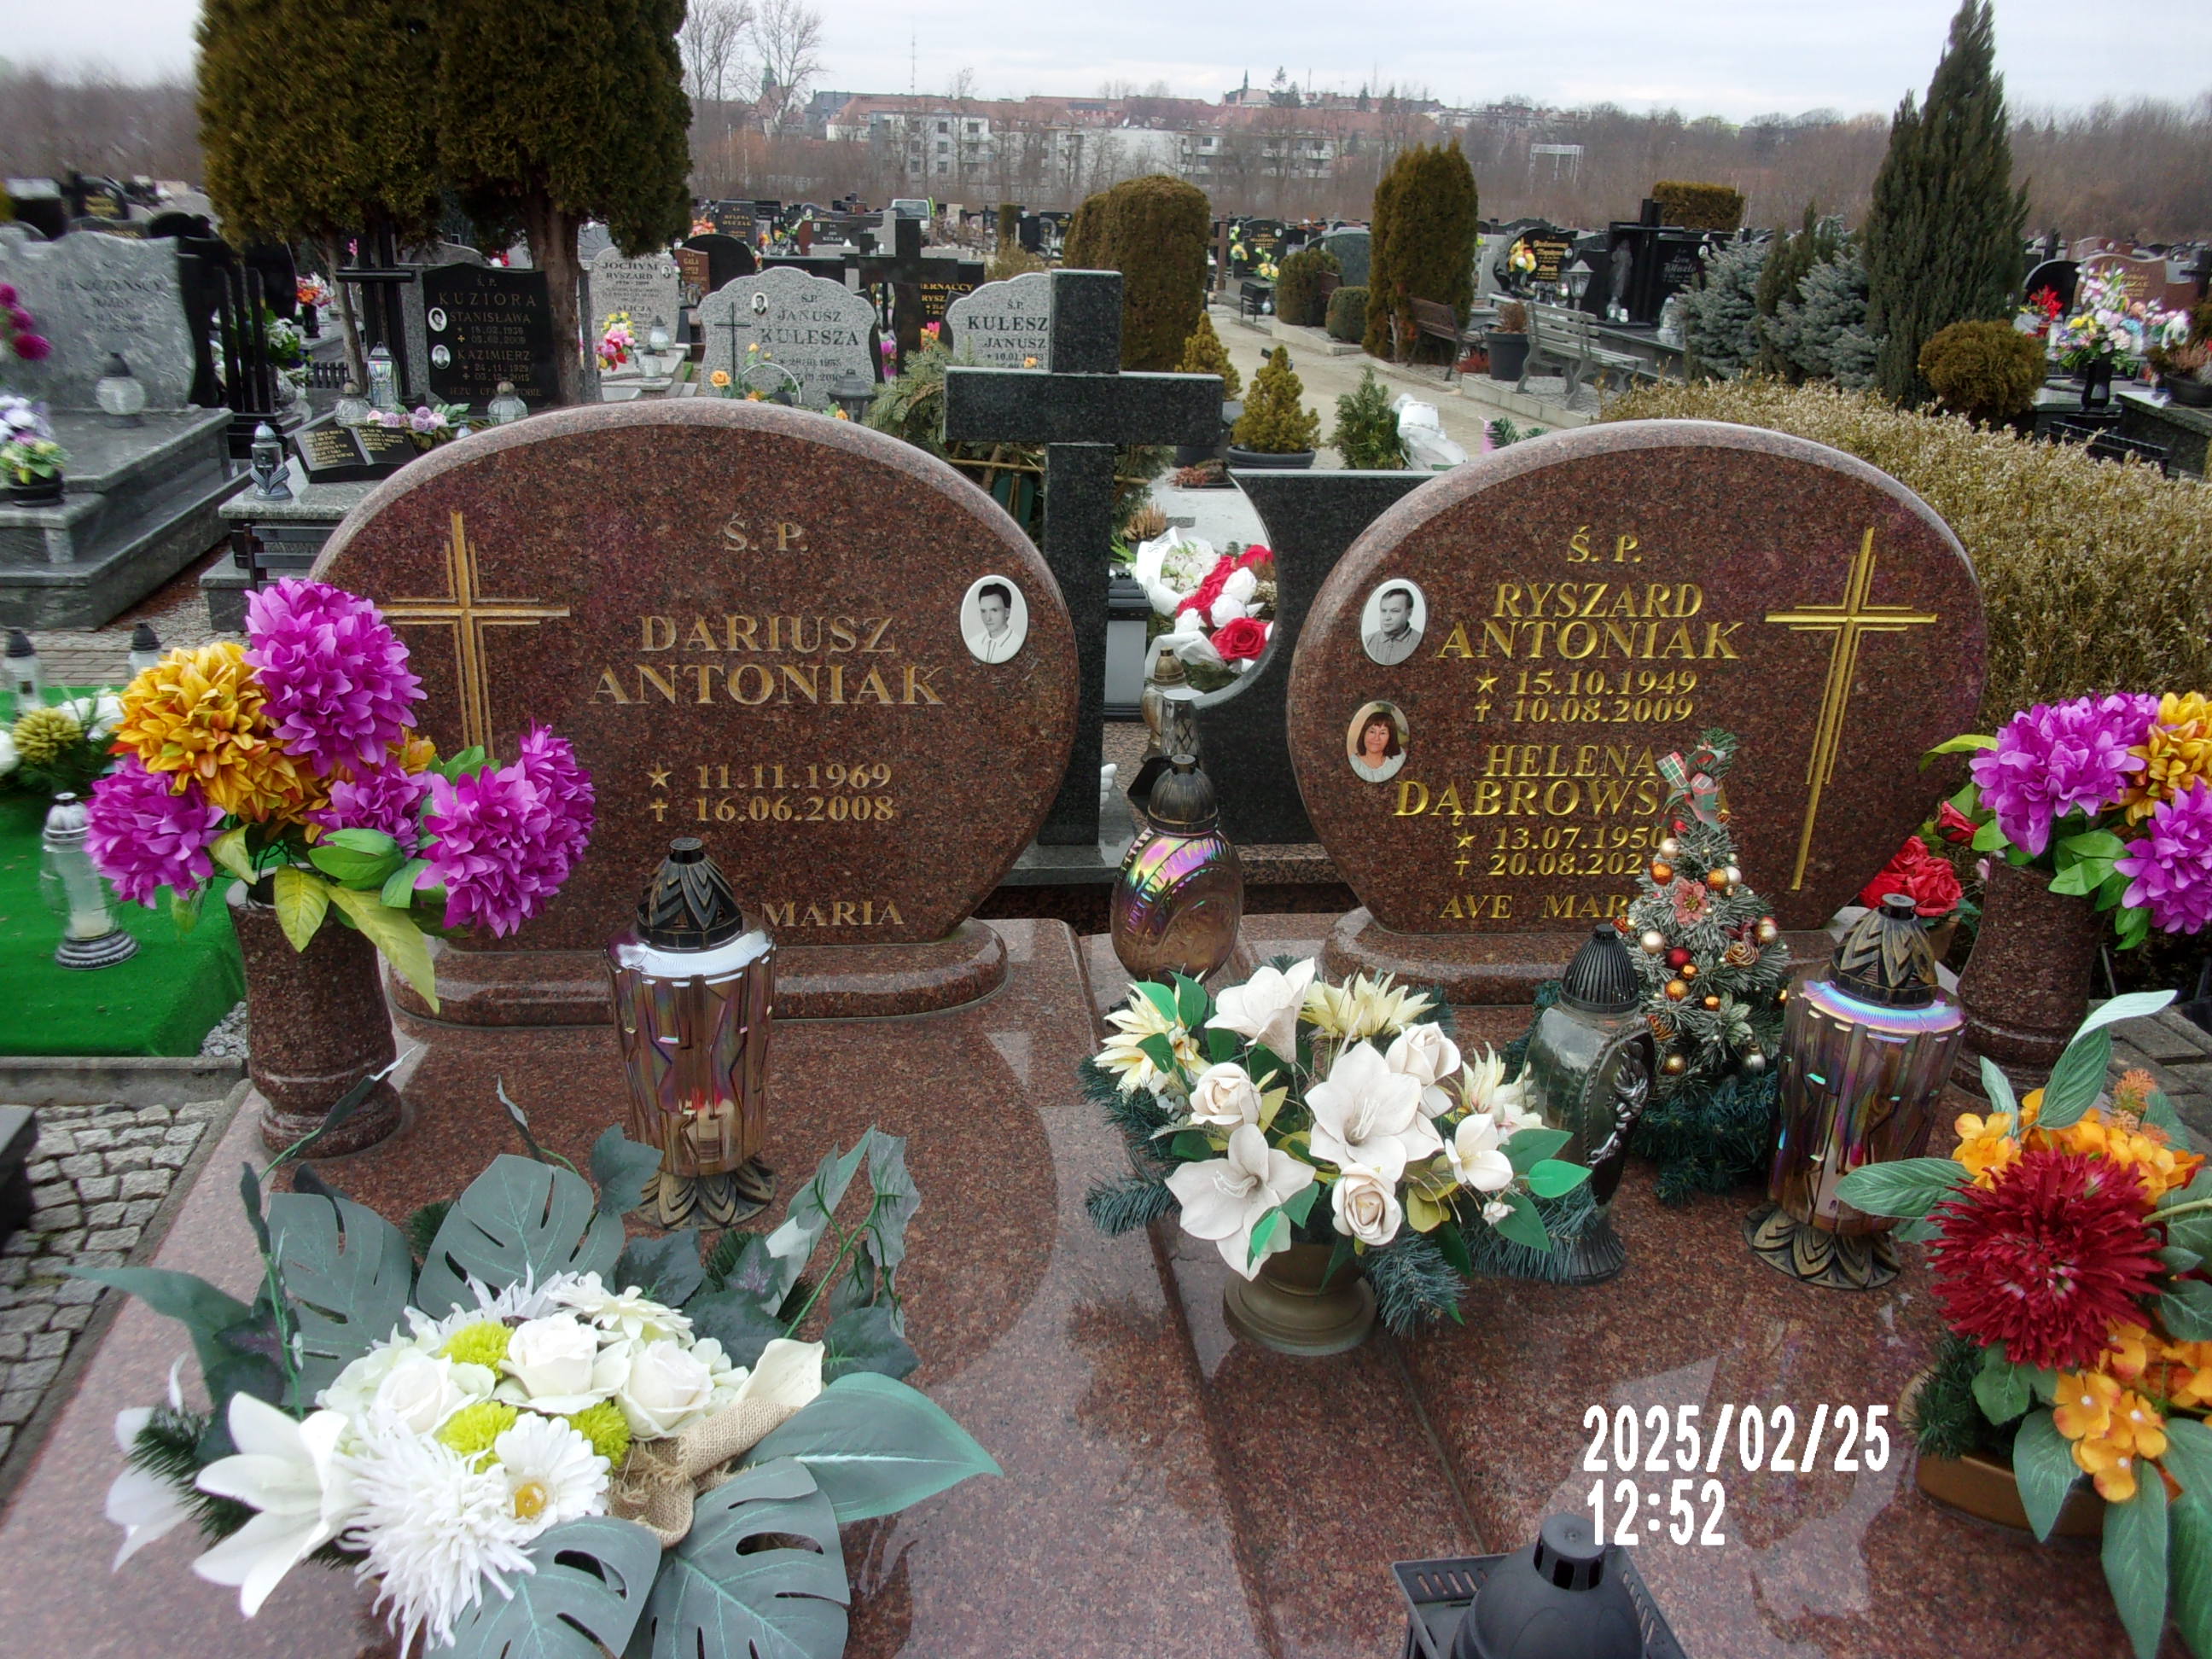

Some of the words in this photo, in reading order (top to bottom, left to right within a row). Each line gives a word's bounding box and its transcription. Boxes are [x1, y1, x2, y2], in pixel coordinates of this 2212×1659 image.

[602, 262, 658, 271] JOCHYM
[439, 292, 537, 307] KUZIORA
[920, 282, 975, 292] IERNACCY
[450, 311, 532, 324] STANISŁAWA
[777, 310, 841, 322] JANUSZ
[967, 316, 1048, 332] KULESZ
[759, 329, 859, 346] KULESZA
[982, 338, 1046, 349] JANUSZ
[457, 350, 531, 361] KAZIMIERZ
[777, 521, 808, 552] P.
[1613, 535, 1642, 563] P.
[1491, 582, 1703, 619] RYSZARD
[639, 614, 896, 653] DARIUSZ
[1435, 620, 1744, 661] ANTONIAK
[588, 663, 946, 705] ANTONIAK
[1514, 670, 1697, 696] 15.10.1949
[1511, 697, 1695, 724] 10.08.2009
[1483, 744, 1658, 777] HELENA
[696, 763, 894, 790] 11.11.1969
[696, 795, 896, 822] 16.06.2008
[1392, 779, 1732, 827] DĄBROWS
[1493, 826, 1668, 851] 13.07.1950
[1488, 852, 1650, 876] 20.08.202
[760, 900, 905, 928] MARIA
[1439, 894, 1513, 919] AVE
[1540, 894, 1644, 919] MAR
